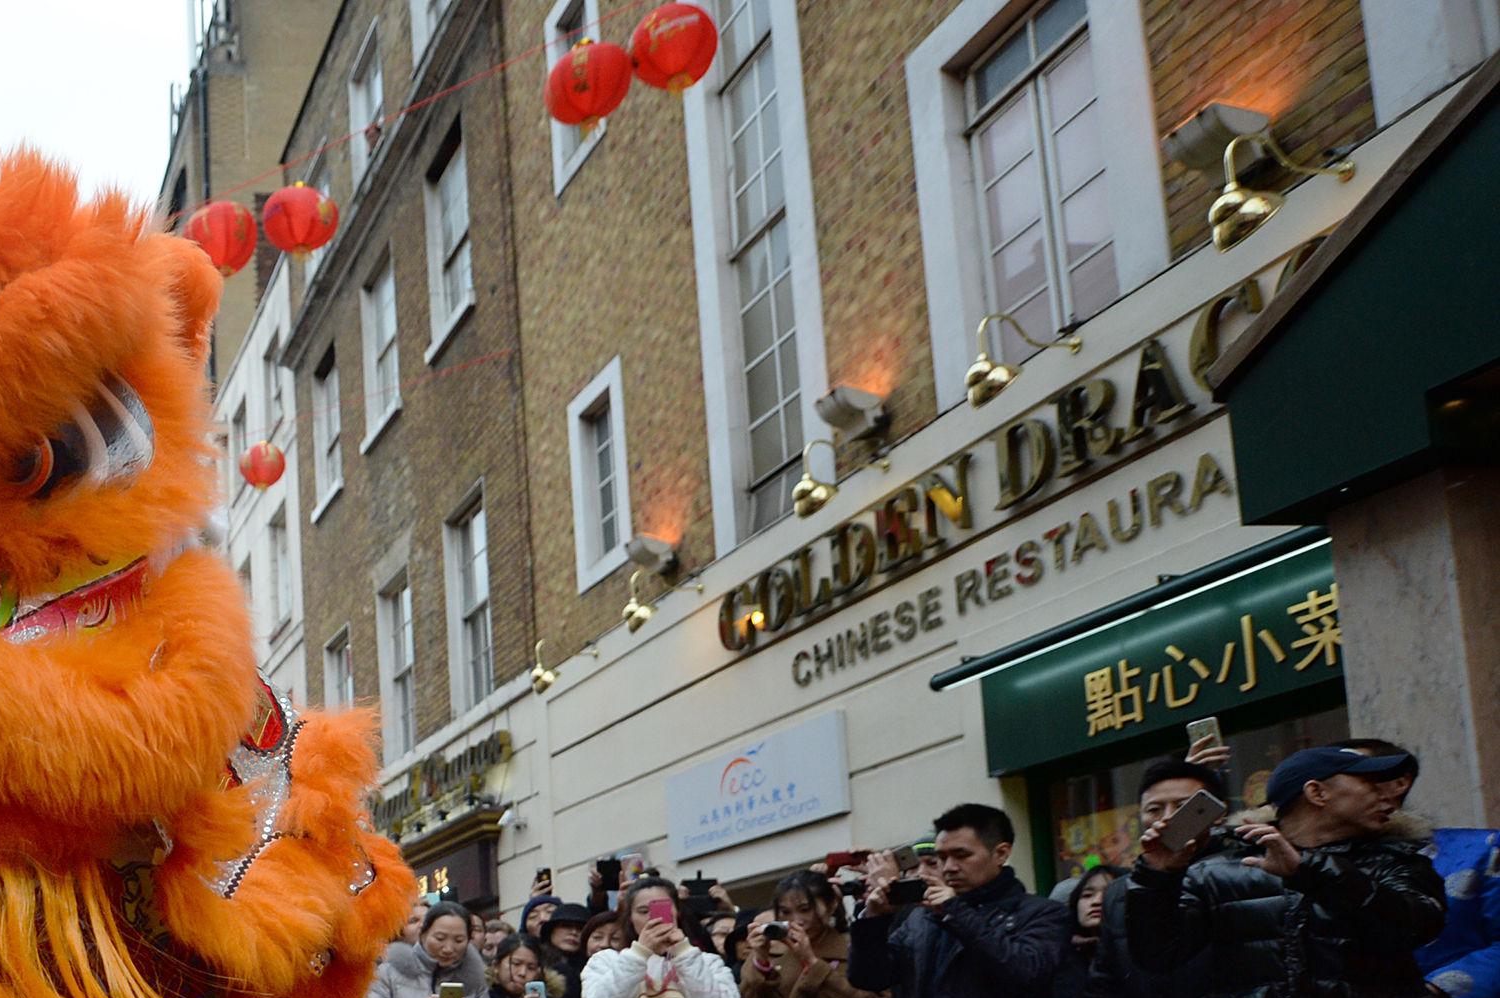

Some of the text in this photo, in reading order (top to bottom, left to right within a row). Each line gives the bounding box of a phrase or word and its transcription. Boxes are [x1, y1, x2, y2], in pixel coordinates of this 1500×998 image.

[719, 240, 1317, 651] GOLDEN DRAG
[792, 586, 943, 687] CHINESE
[1084, 582, 1343, 738] 點心小菜
